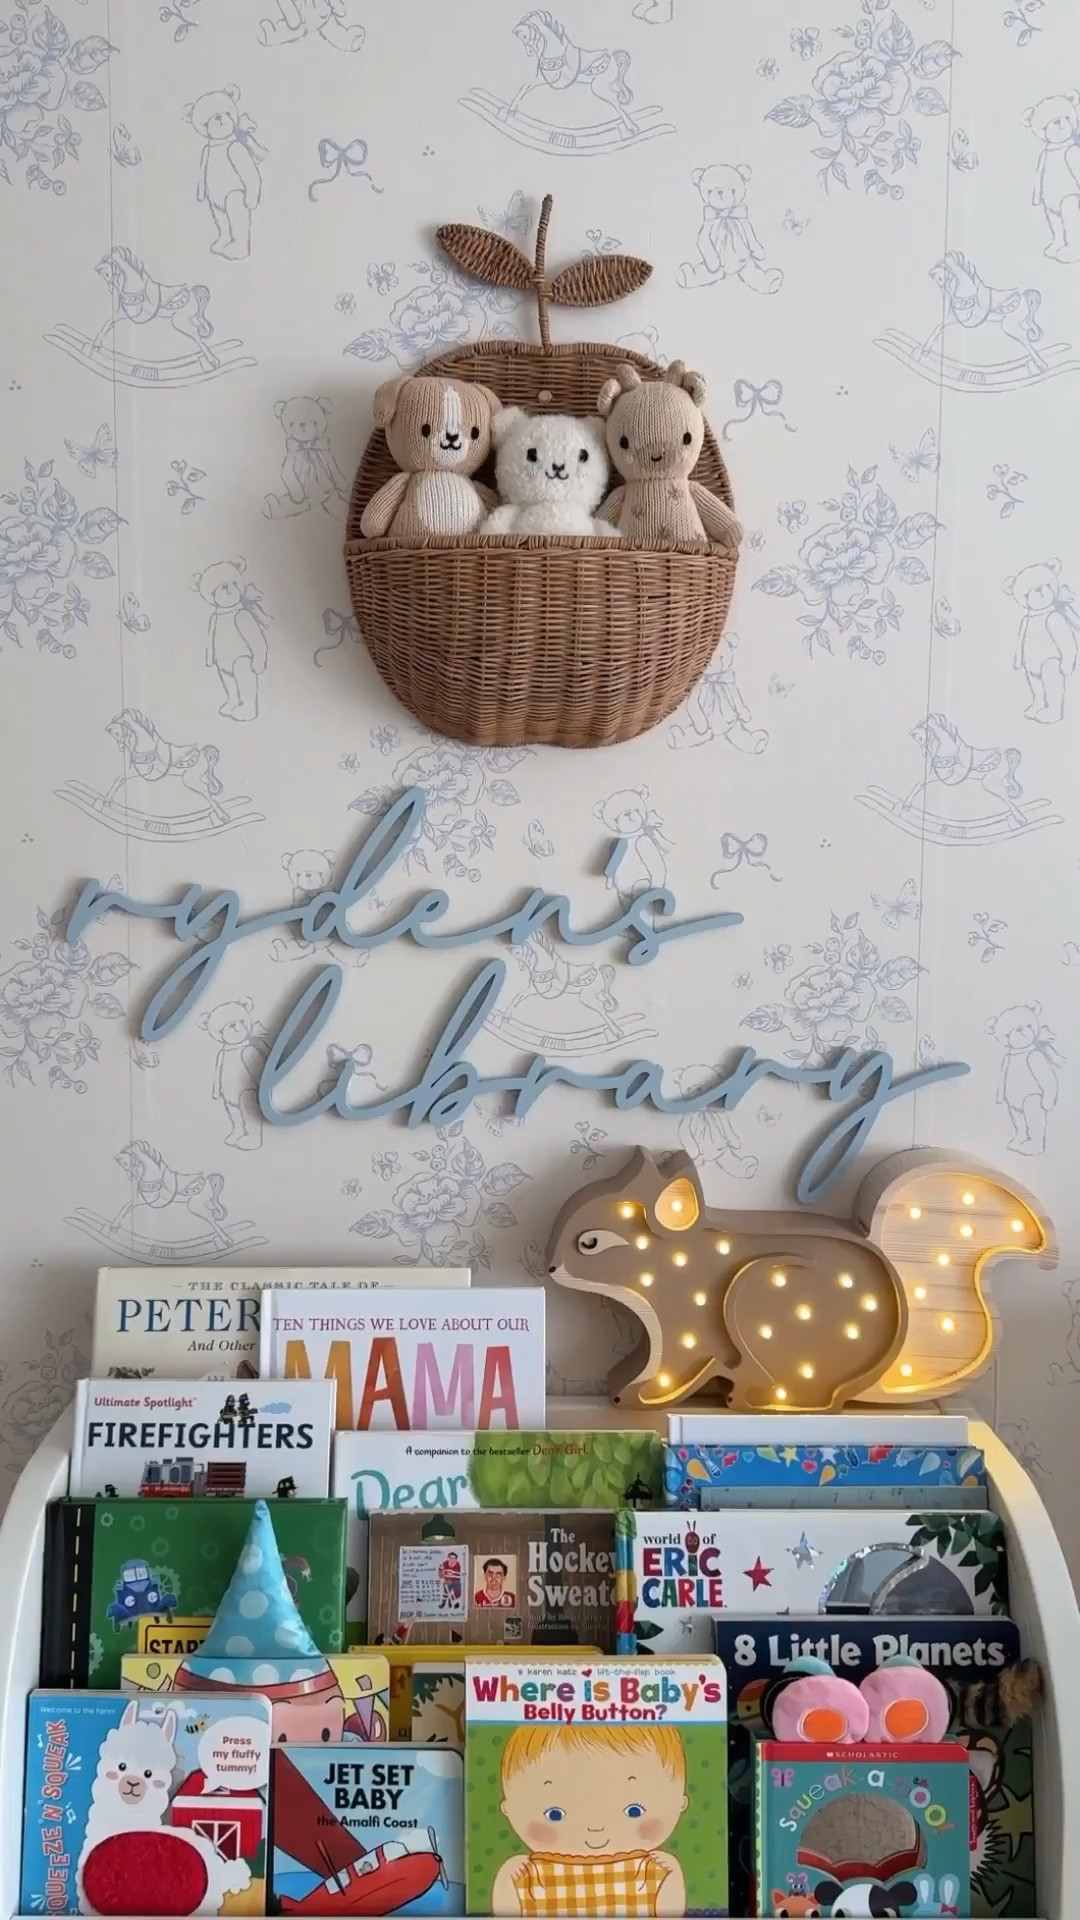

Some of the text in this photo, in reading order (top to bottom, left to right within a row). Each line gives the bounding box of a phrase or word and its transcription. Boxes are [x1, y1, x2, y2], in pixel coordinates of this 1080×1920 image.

[64, 785, 744, 1042] ryden's
[257, 958, 971, 1204] library
[188, 1281, 223, 1291] THE
[230, 1281, 303, 1291] CLASSIC
[309, 1281, 351, 1289] TALE
[116, 1299, 261, 1333] PETER
[273, 1318, 530, 1331] TEN THINGS WE LOVE ABOUT OUR
[187, 1340, 256, 1352] And Other
[284, 1337, 519, 1430] MAMA
[94, 1397, 140, 1407] Ultimate
[88, 1421, 314, 1449] FIREFIGHTERS
[406, 1446, 413, 1455] A
[414, 1446, 459, 1458] companion
[461, 1446, 470, 1455] to
[473, 1446, 486, 1456] the
[489, 1446, 530, 1456] bestseller
[533, 1444, 560, 1456] Dear
[351, 1469, 468, 1520] Dear
[550, 1527, 576, 1543] The
[643, 1533, 717, 1544] world of
[734, 1633, 1005, 1667] 8 Little Planets
[527, 1668, 553, 1676] karen
[654, 1668, 677, 1676] book
[472, 1674, 722, 1712] Where is Baby's
[40, 1706, 72, 1714] Welcome
[524, 1703, 668, 1726] Belly Button?
[222, 1736, 252, 1745] Press
[42, 1719, 69, 1800] SQUEAK
[212, 1749, 261, 1761] my fluffy
[835, 1751, 899, 1759] SCHOLASTIC
[216, 1764, 257, 1775] tummy!
[324, 1763, 415, 1786] JET SET
[334, 1787, 404, 1810] BABY
[317, 1815, 418, 1829] the Amalfi Coast
